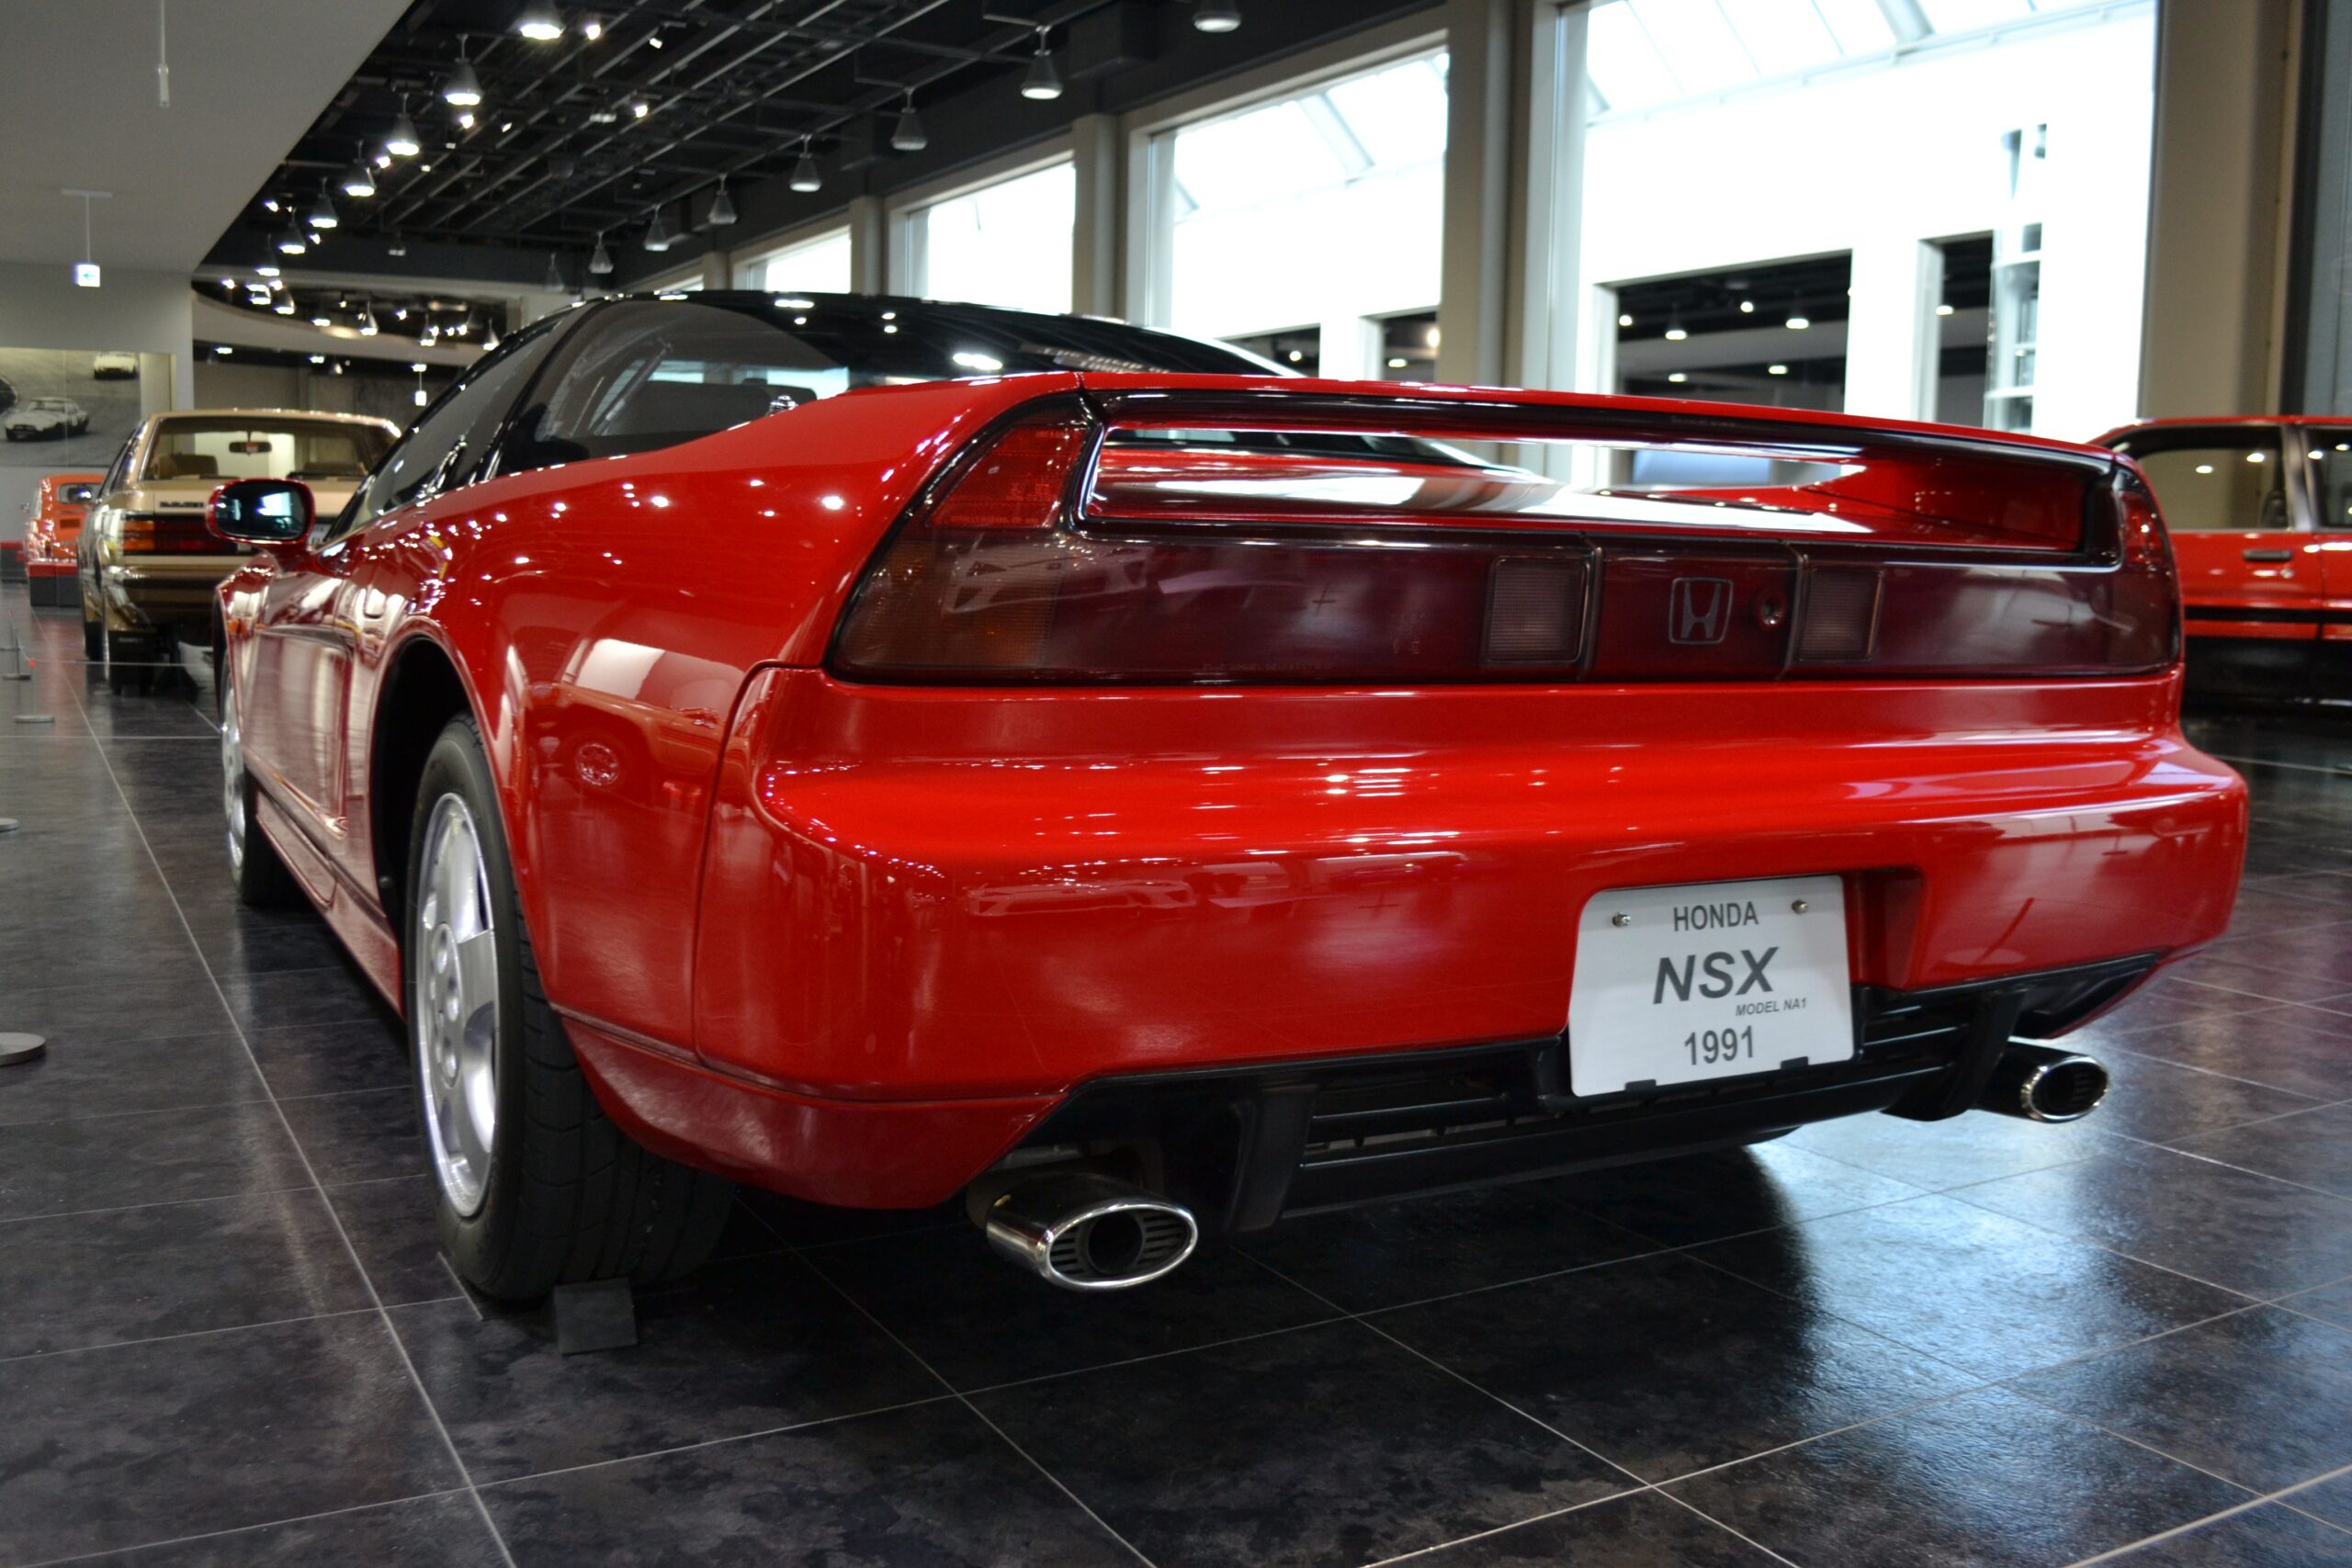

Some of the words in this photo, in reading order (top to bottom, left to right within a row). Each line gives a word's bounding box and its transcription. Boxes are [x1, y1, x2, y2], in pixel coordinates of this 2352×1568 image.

[1673, 901, 1759, 931] HONDA
[1653, 947, 1780, 1005] NSX
[1736, 1001, 1781, 1016] MODEL
[1783, 998, 1807, 1011] NA1
[1683, 1025, 1755, 1066] 1991
